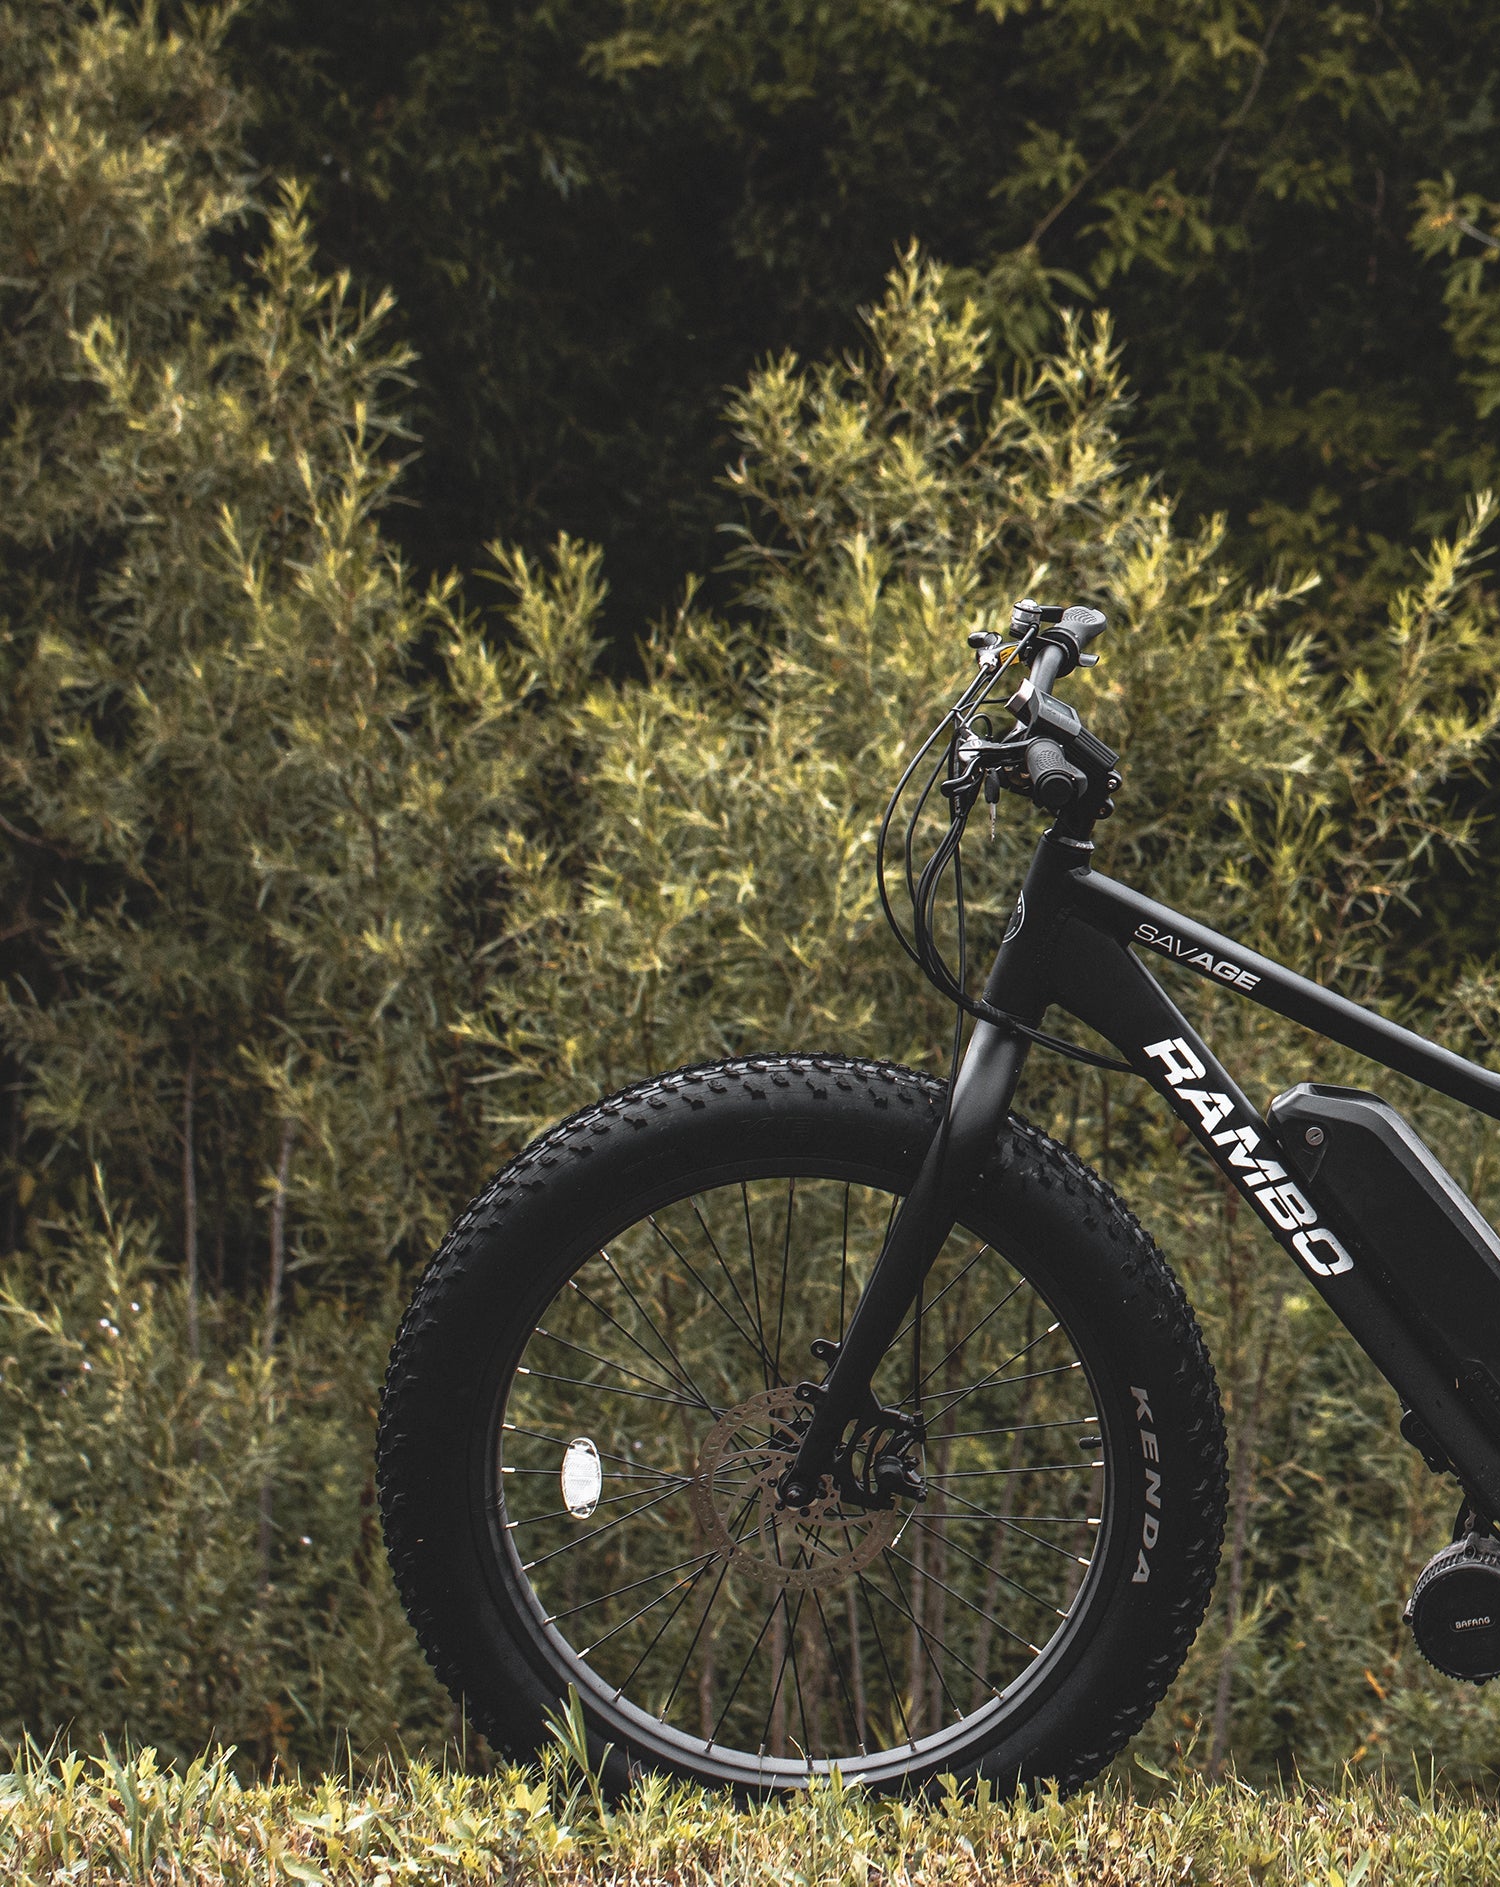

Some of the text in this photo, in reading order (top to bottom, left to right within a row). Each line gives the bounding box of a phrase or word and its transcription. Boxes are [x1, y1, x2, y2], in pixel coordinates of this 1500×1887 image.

[1133, 923, 1262, 991] SAVAGE
[1142, 1036, 1354, 1277] RAMBO
[1130, 1385, 1162, 1584] KENDA
[1455, 1616, 1491, 1630] BAFANG
